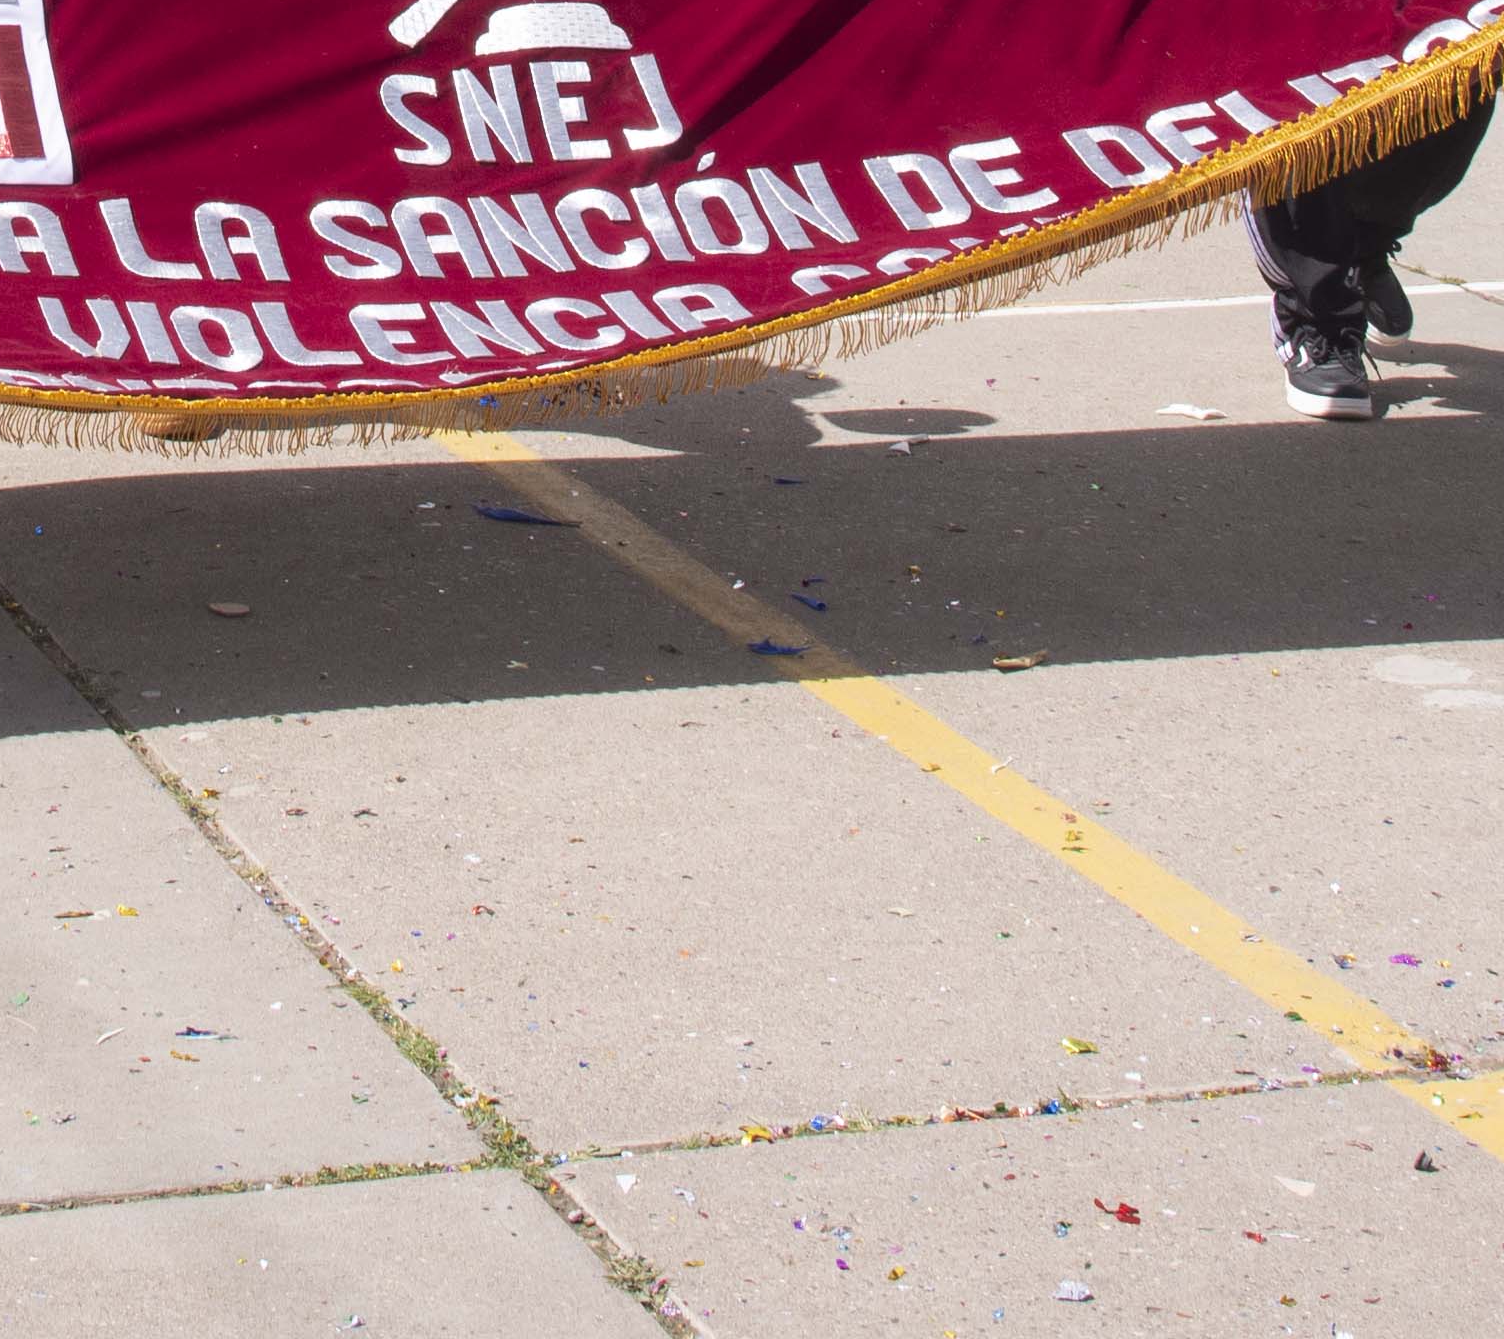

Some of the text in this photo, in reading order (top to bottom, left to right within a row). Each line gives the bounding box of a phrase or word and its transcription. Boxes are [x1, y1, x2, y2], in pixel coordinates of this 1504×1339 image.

[379, 53, 684, 168] SNEJ
[98, 197, 291, 281] LA
[309, 151, 859, 281] SANCIÓN
[863, 137, 1060, 232] DE
[37, 282, 754, 373] VIOLENCIA
